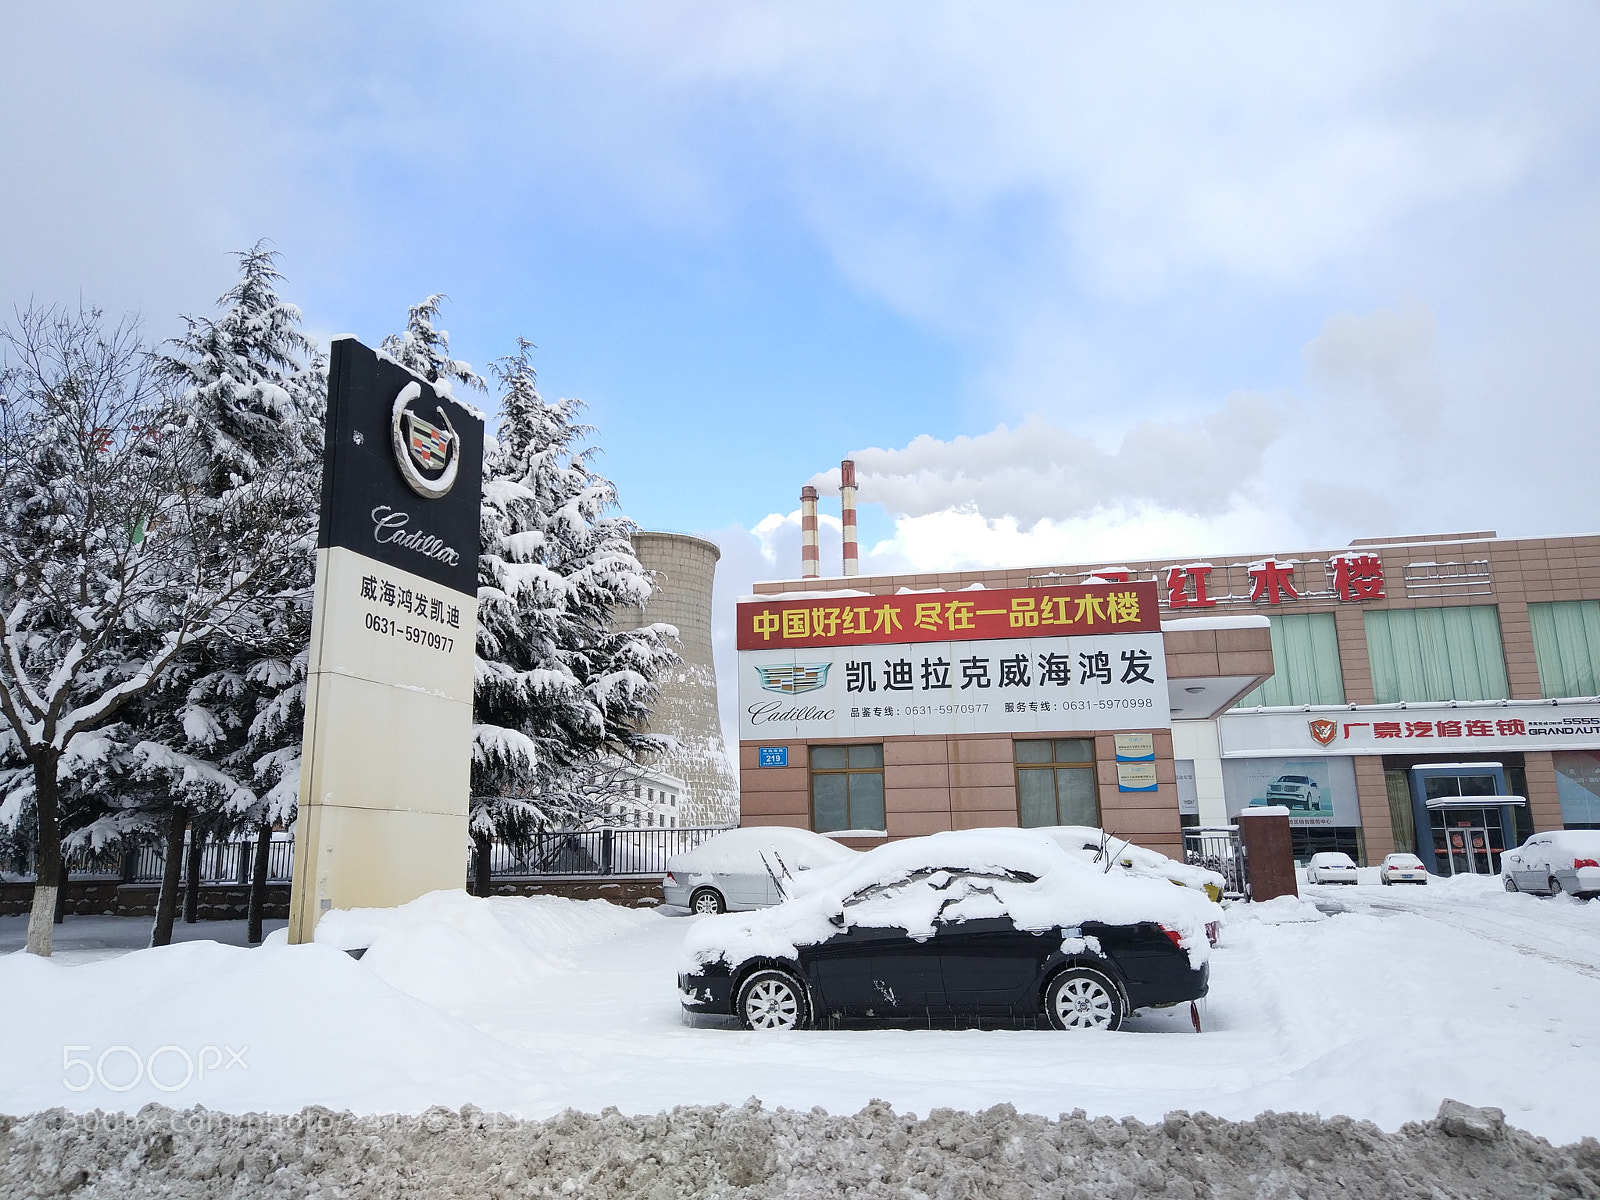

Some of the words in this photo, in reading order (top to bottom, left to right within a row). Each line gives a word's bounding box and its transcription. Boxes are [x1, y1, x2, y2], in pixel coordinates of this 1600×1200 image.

[371, 505, 460, 567] Cadillac
[360, 574, 460, 630] 威海鸿发凯迪
[752, 603, 904, 641] 中国好红木
[914, 591, 1143, 632] 尽在一品红木楼
[364, 612, 455, 654] 0631-5970977
[845, 649, 1156, 693] 凯迪拉克威海鸿发
[747, 700, 836, 725] Cadillac
[1343, 718, 1527, 740] 广豪汽修连锁
